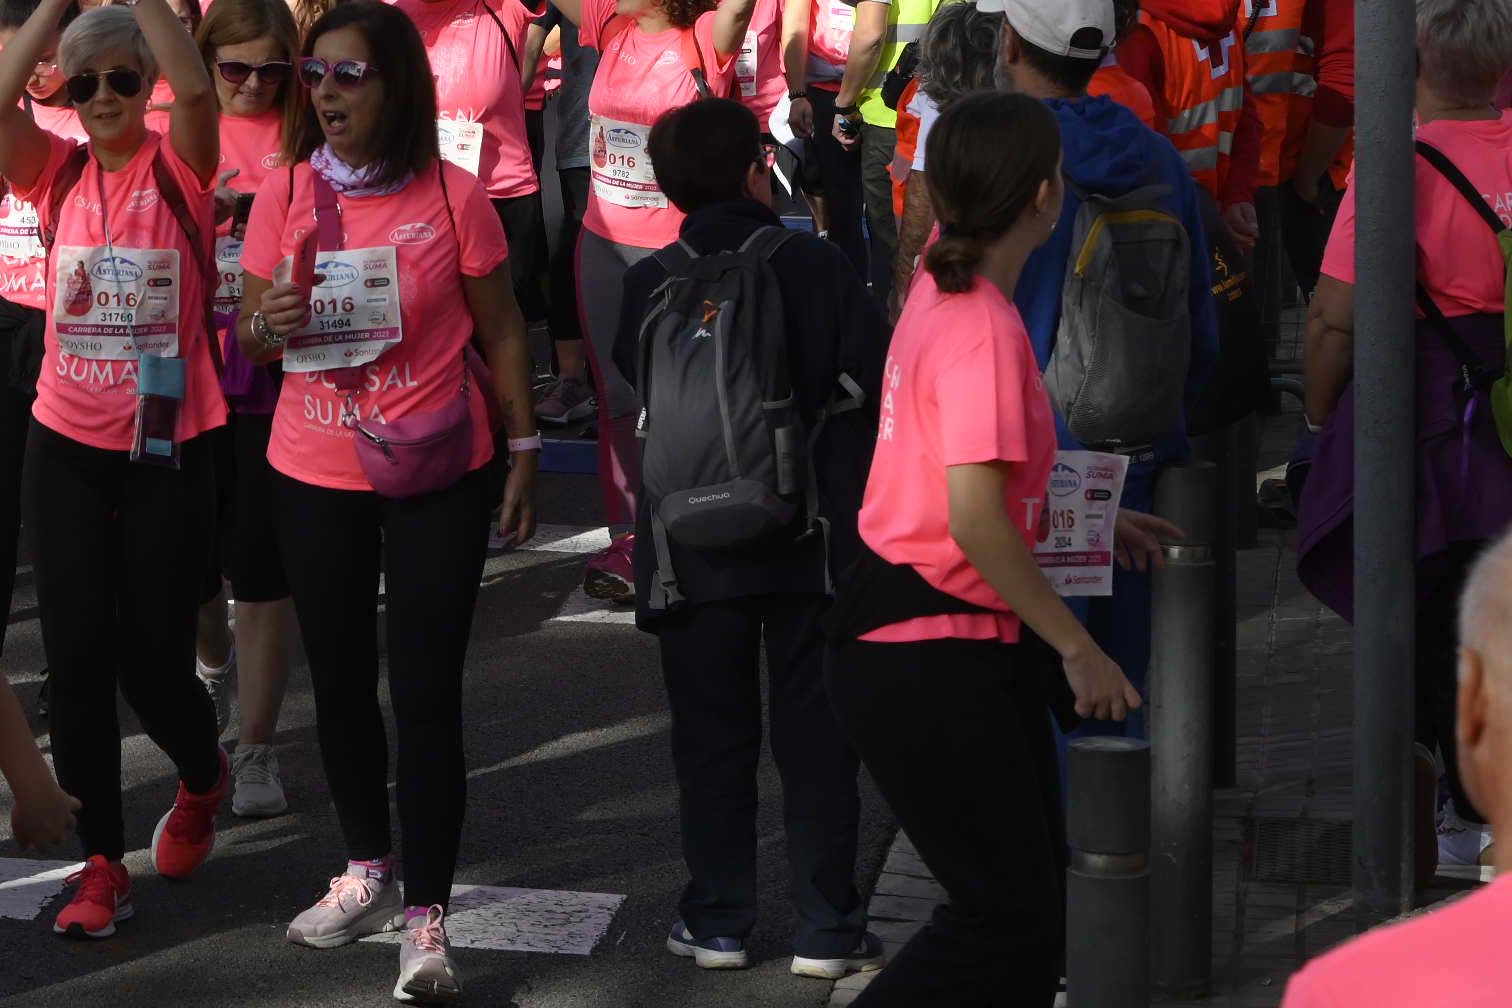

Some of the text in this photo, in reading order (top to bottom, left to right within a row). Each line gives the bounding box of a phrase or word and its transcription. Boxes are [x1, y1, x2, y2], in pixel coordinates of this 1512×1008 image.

[608, 153, 636, 168] 016
[96, 291, 138, 308] 016
[313, 296, 356, 315] 016
[67, 325, 102, 335] CARRERA
[103, 325, 113, 335] DE
[114, 325, 125, 335] LA
[345, 332, 371, 341] MUJER
[65, 340, 103, 352] OYSHO
[56, 352, 138, 386] SUMA
[1051, 508, 1075, 529] 016
